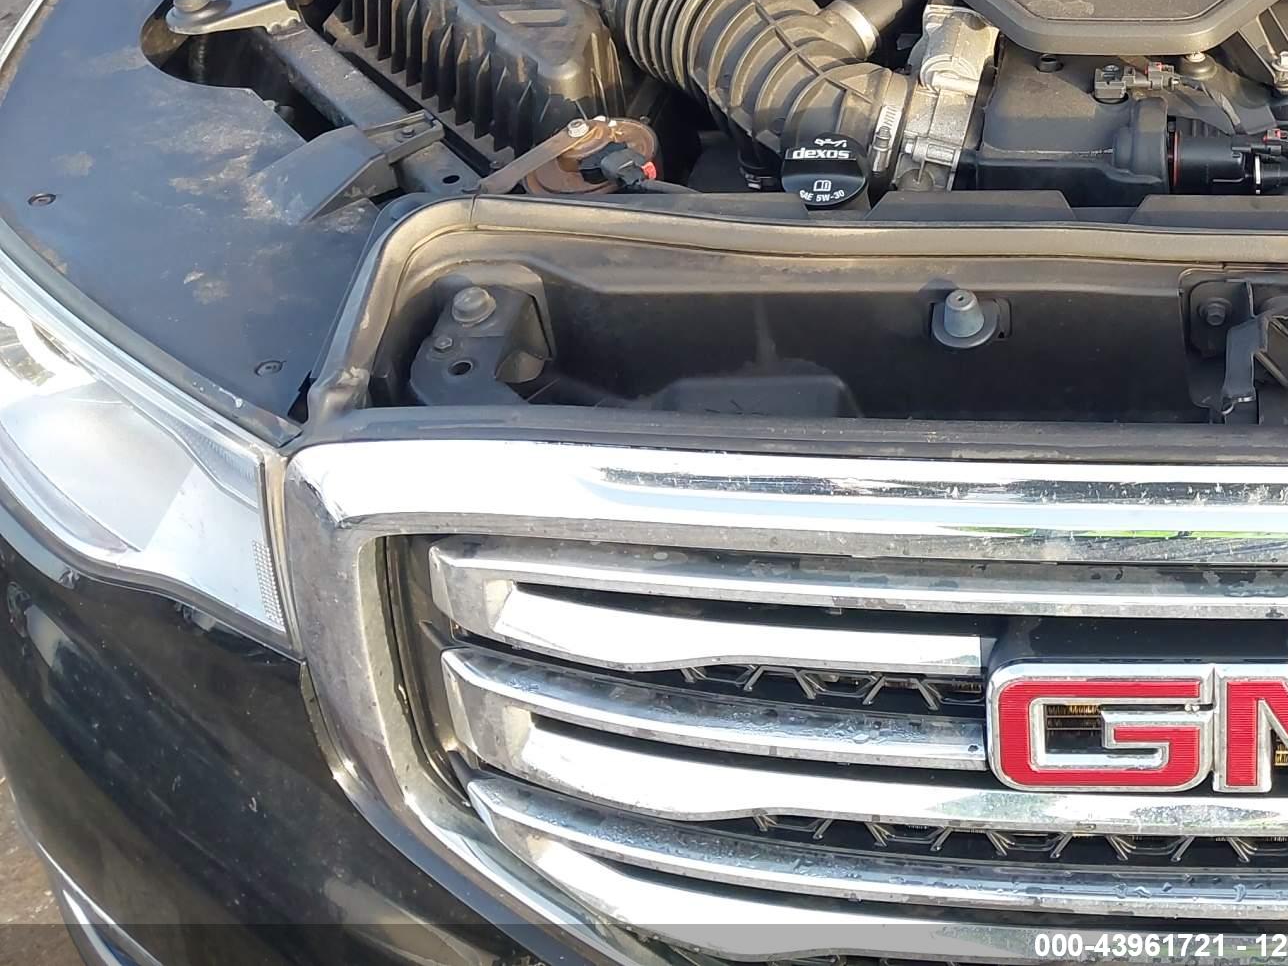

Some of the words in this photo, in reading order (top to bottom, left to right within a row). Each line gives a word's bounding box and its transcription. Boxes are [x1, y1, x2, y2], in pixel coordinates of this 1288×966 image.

[792, 147, 850, 159] dexos
[799, 189, 814, 201] SAE
[815, 189, 845, 202] 5W-30
